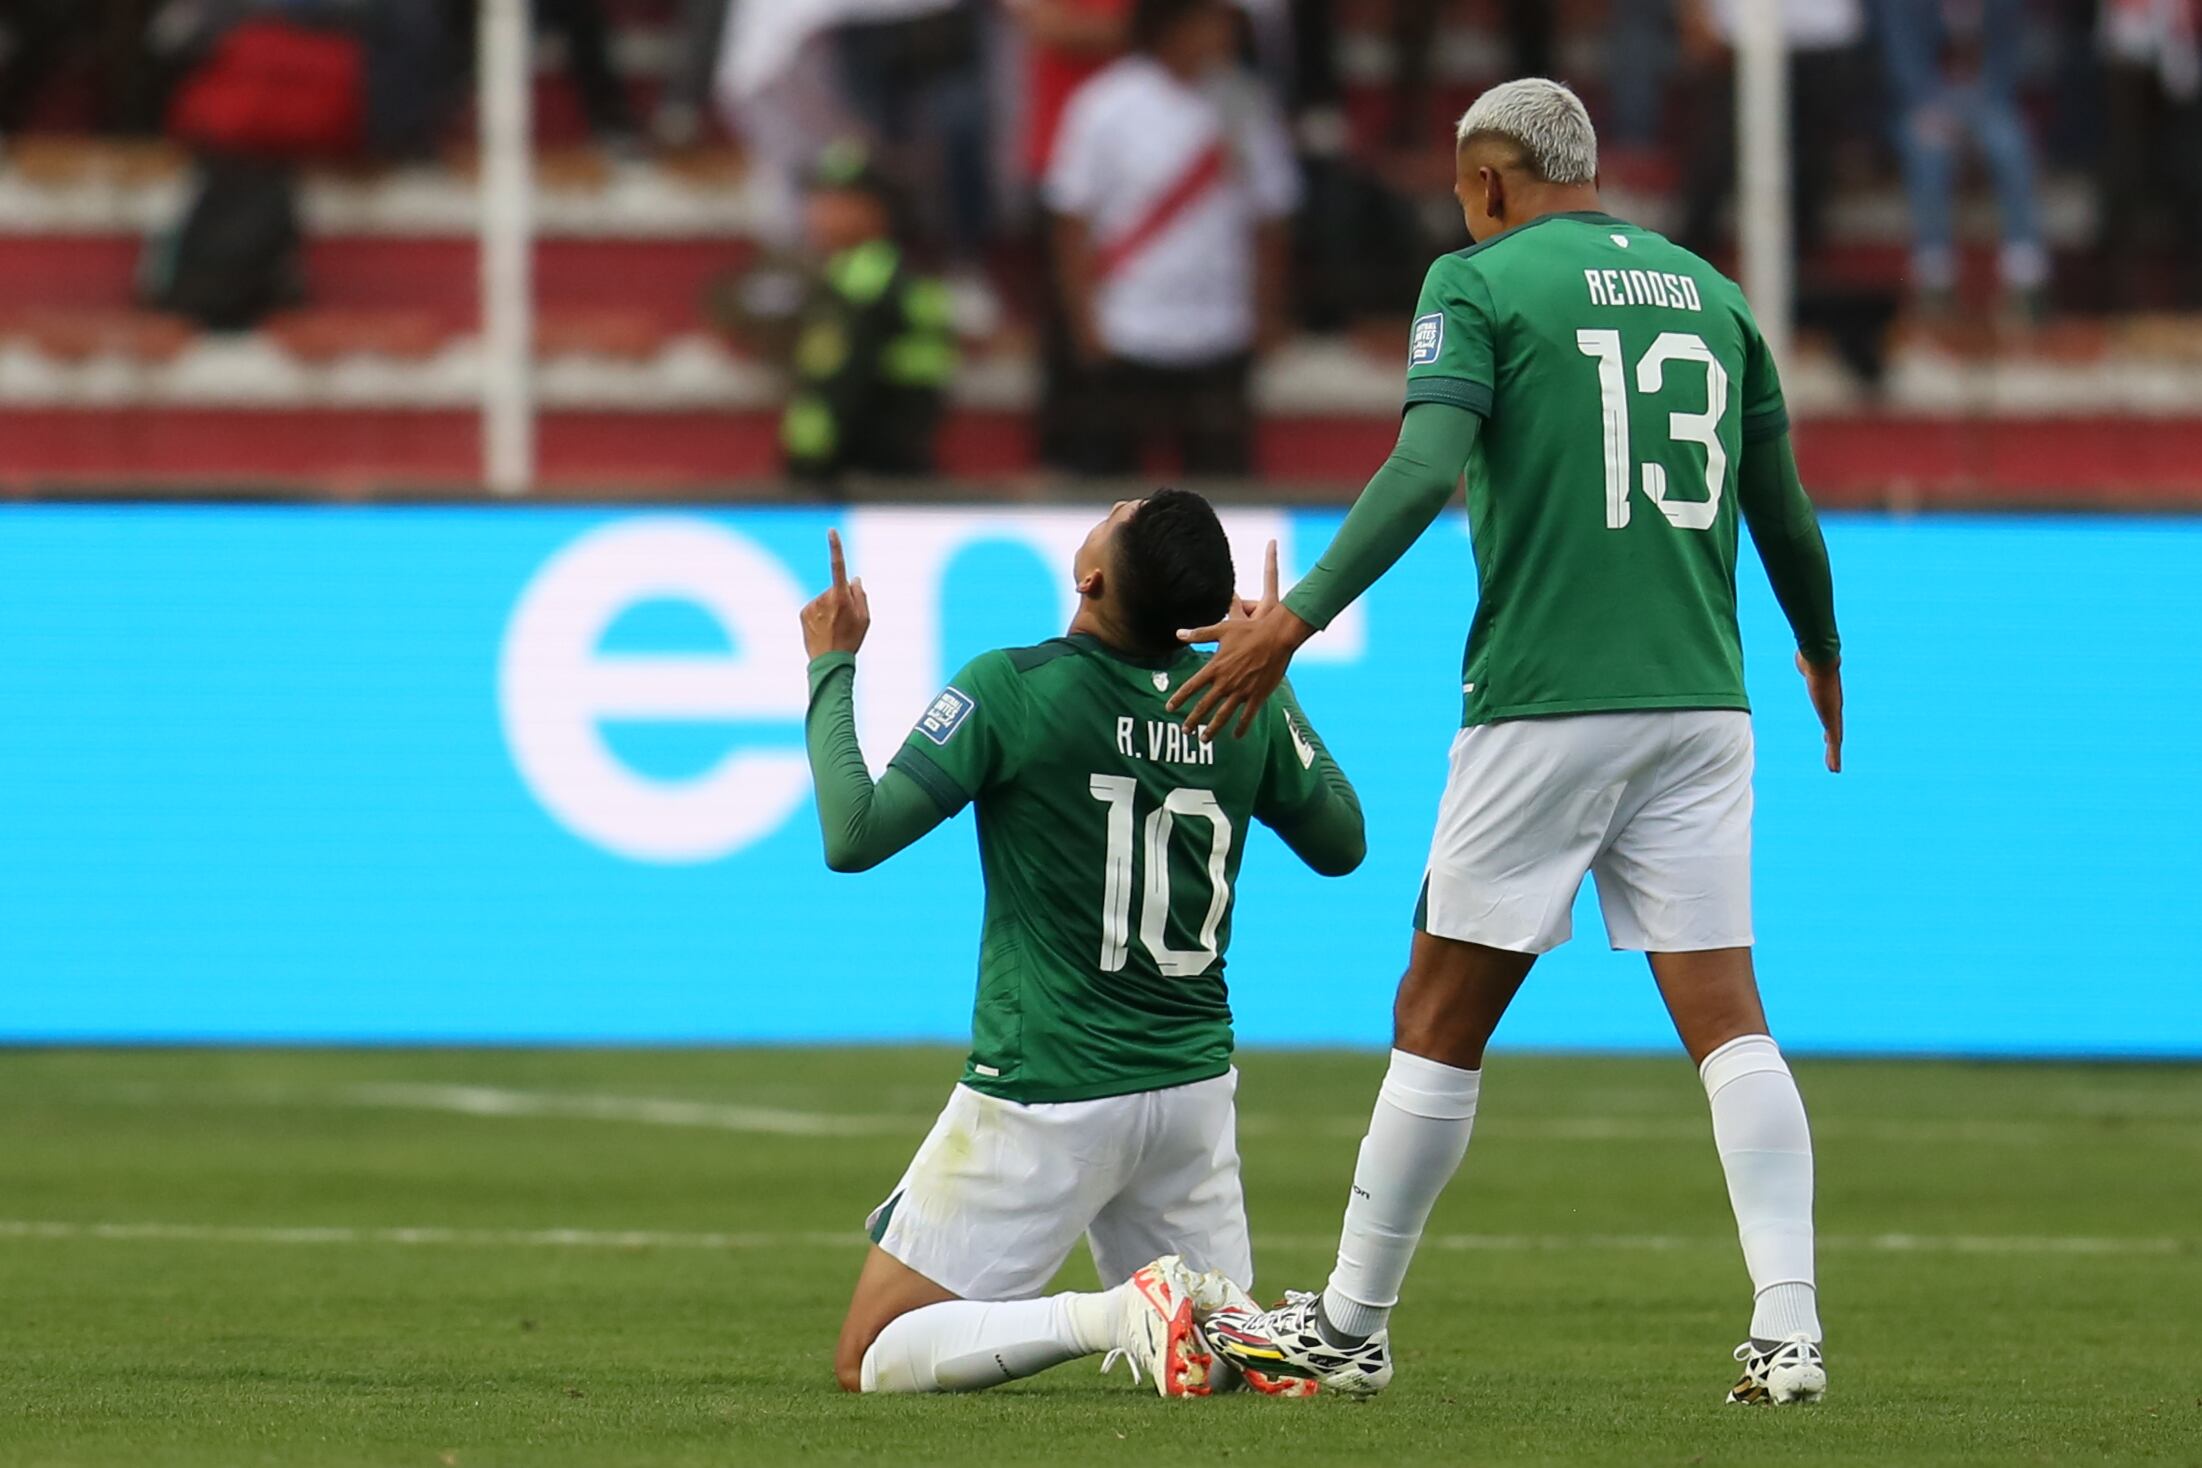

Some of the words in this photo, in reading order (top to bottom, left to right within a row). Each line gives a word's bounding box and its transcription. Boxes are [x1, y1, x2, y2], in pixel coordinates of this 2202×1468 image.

[1584, 269, 1701, 311] REINOSO
[1576, 329, 1728, 530] 13
[1089, 773, 1232, 976] 10
